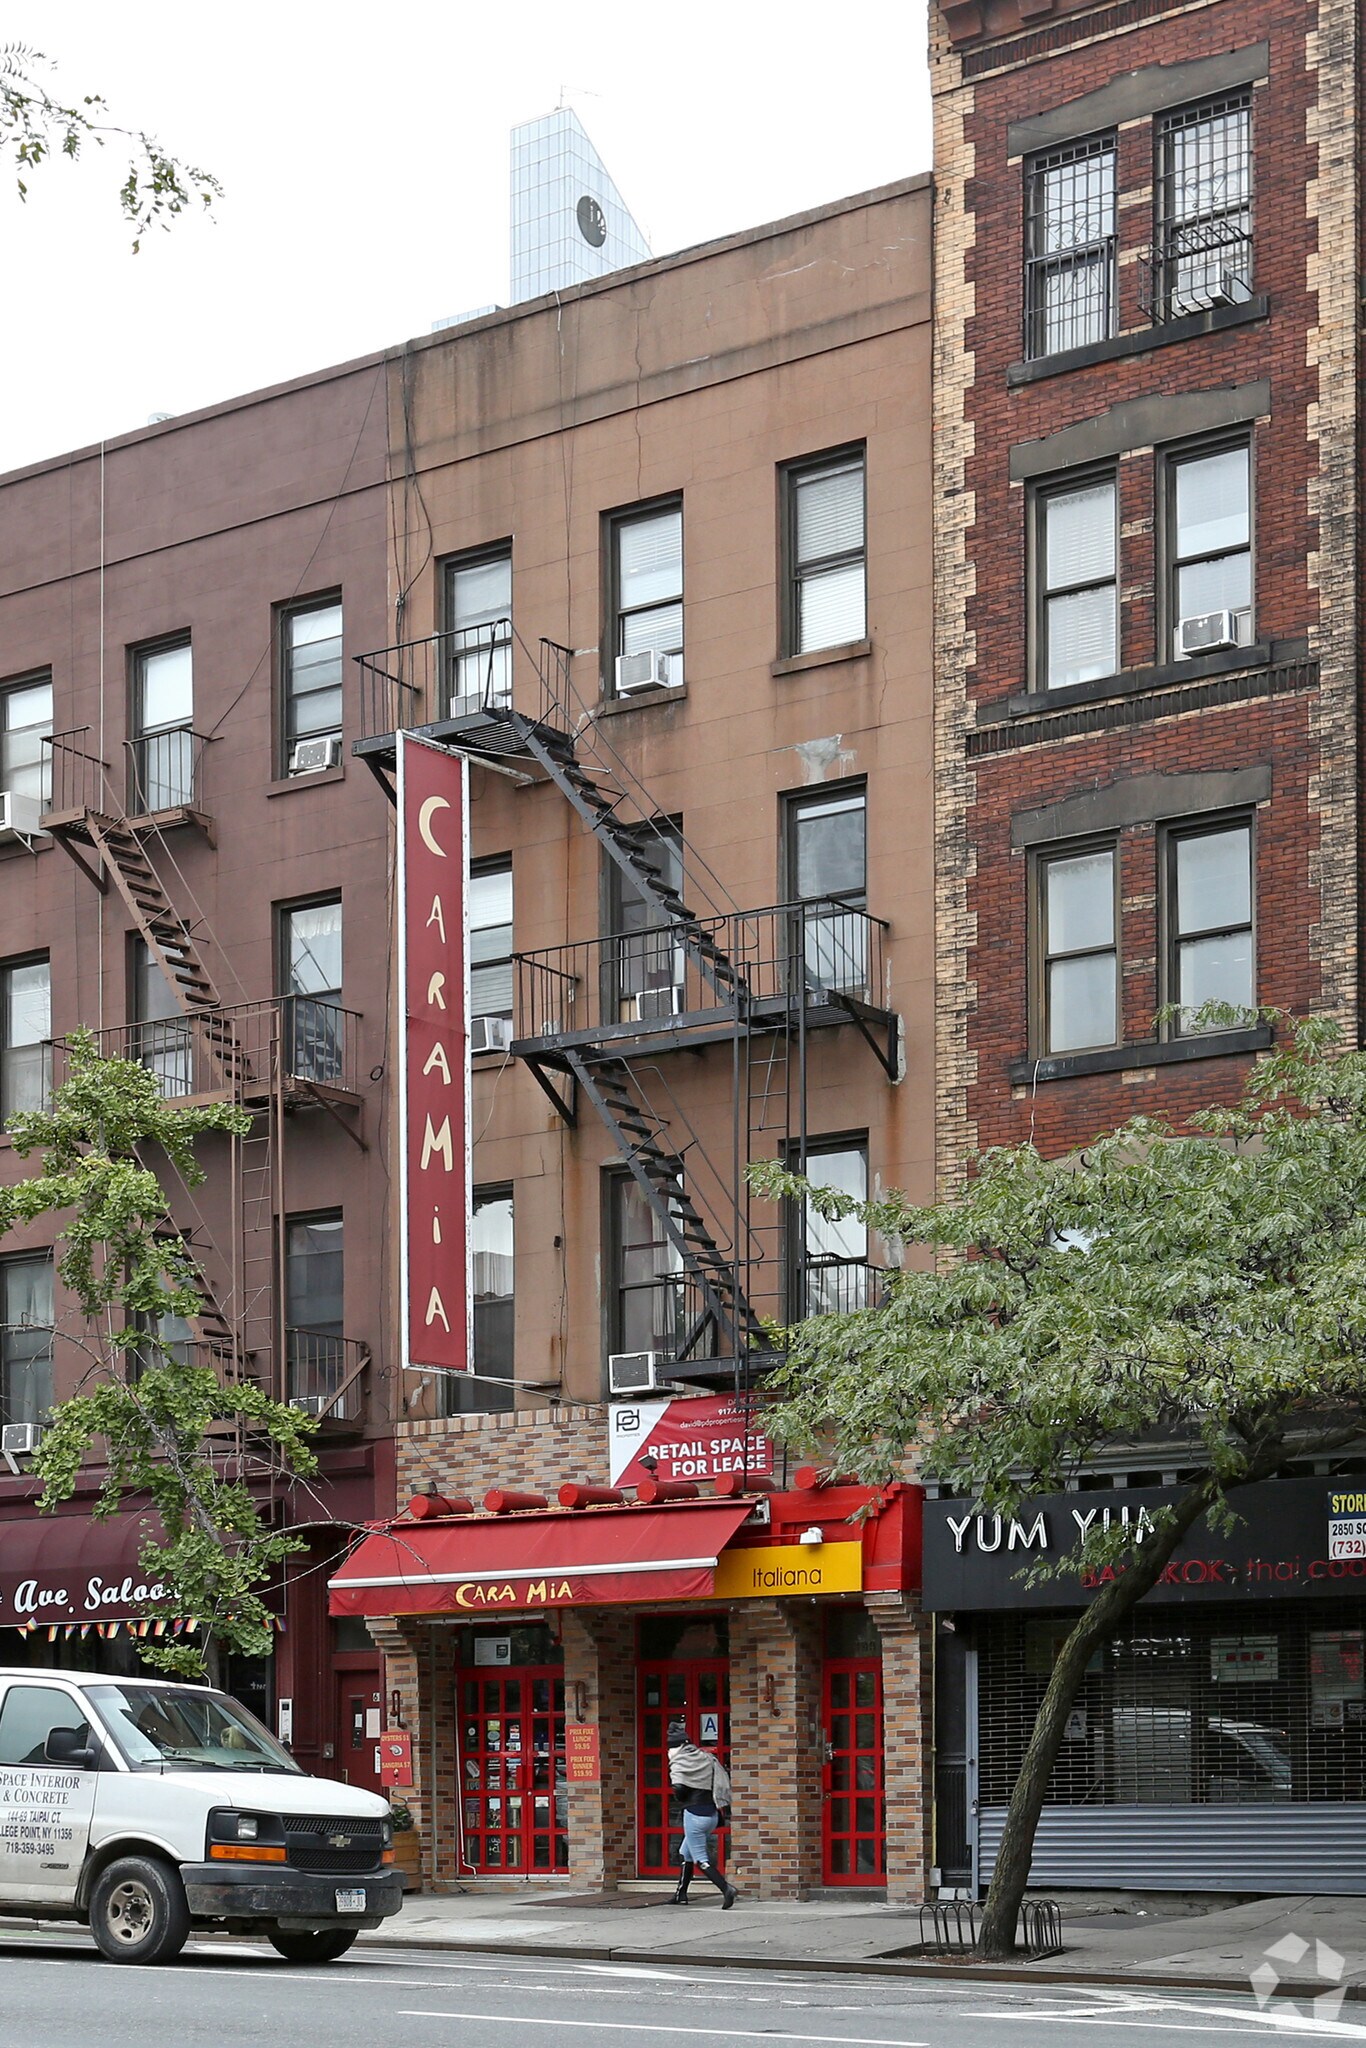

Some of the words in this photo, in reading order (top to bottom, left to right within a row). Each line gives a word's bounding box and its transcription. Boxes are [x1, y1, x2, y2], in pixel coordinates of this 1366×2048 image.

[649, 1440, 706, 1460] RETAIL
[710, 1436, 766, 1452] SPACE
[672, 1461, 707, 1476] FOR
[713, 1454, 766, 1473] LEASE
[1332, 1494, 1366, 1514] STOR
[946, 1511, 1048, 1552] YUM
[1332, 1523, 1353, 1536] 2850
[1332, 1540, 1366, 1557] (732)
[753, 1567, 822, 1588] Italiana
[1246, 1556, 1299, 1581] thai
[455, 1583, 517, 1608] CARA
[704, 1716, 717, 1733] A
[583, 1755, 595, 1763] FIXE
[30, 1772, 81, 1790] INTERIOR
[3, 1789, 11, 1802] &
[14, 1787, 70, 1805] CONCRETE
[29, 1810, 51, 1823] TAIPAI
[0, 1825, 19, 1838] LEGE
[42, 1826, 52, 1840] NY
[54, 1827, 73, 1840] 11356
[6, 1841, 55, 1856] 718-359-3495
